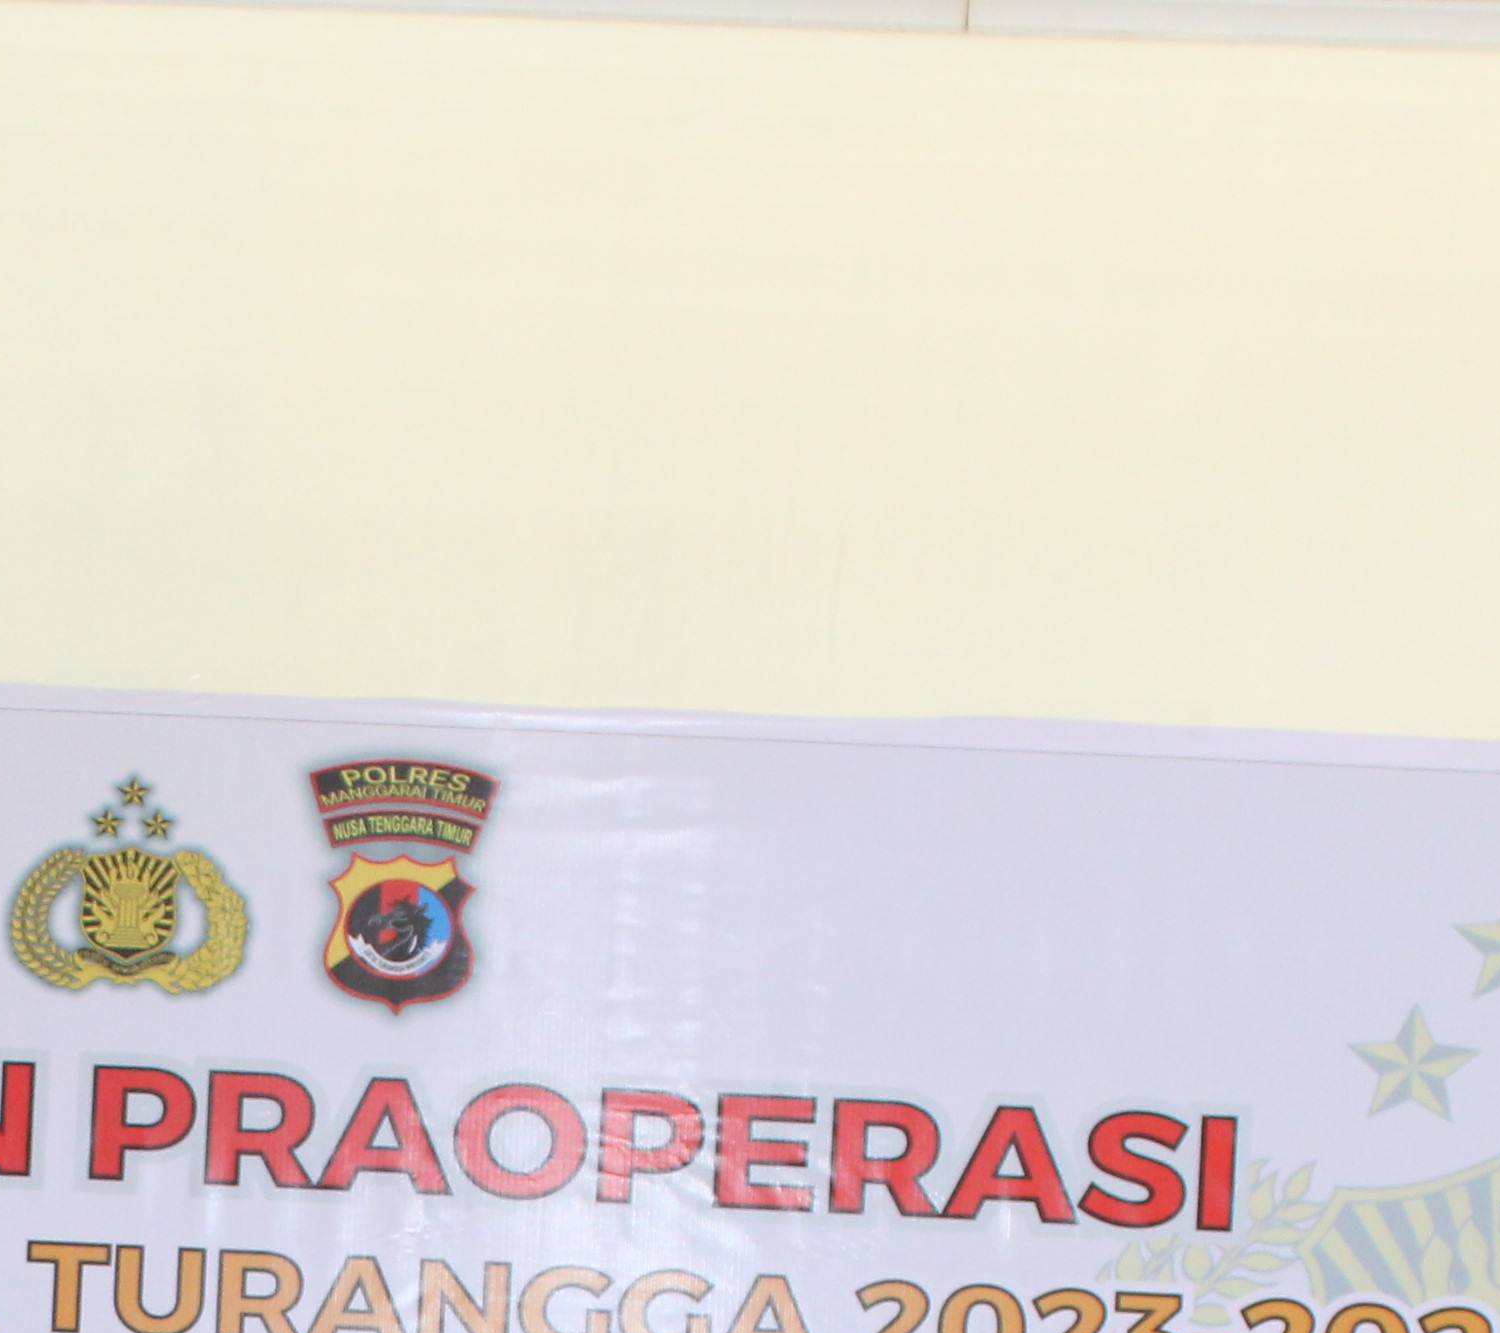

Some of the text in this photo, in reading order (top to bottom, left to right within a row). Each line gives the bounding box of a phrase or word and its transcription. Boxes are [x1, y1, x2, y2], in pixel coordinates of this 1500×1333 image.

[341, 766, 471, 792] POLRES
[320, 784, 487, 812] MANGGARAI TIMUR
[332, 815, 473, 846] NUSA TENGGARA TIMUR
[88, 1064, 1238, 1232] PRAOPERASI
